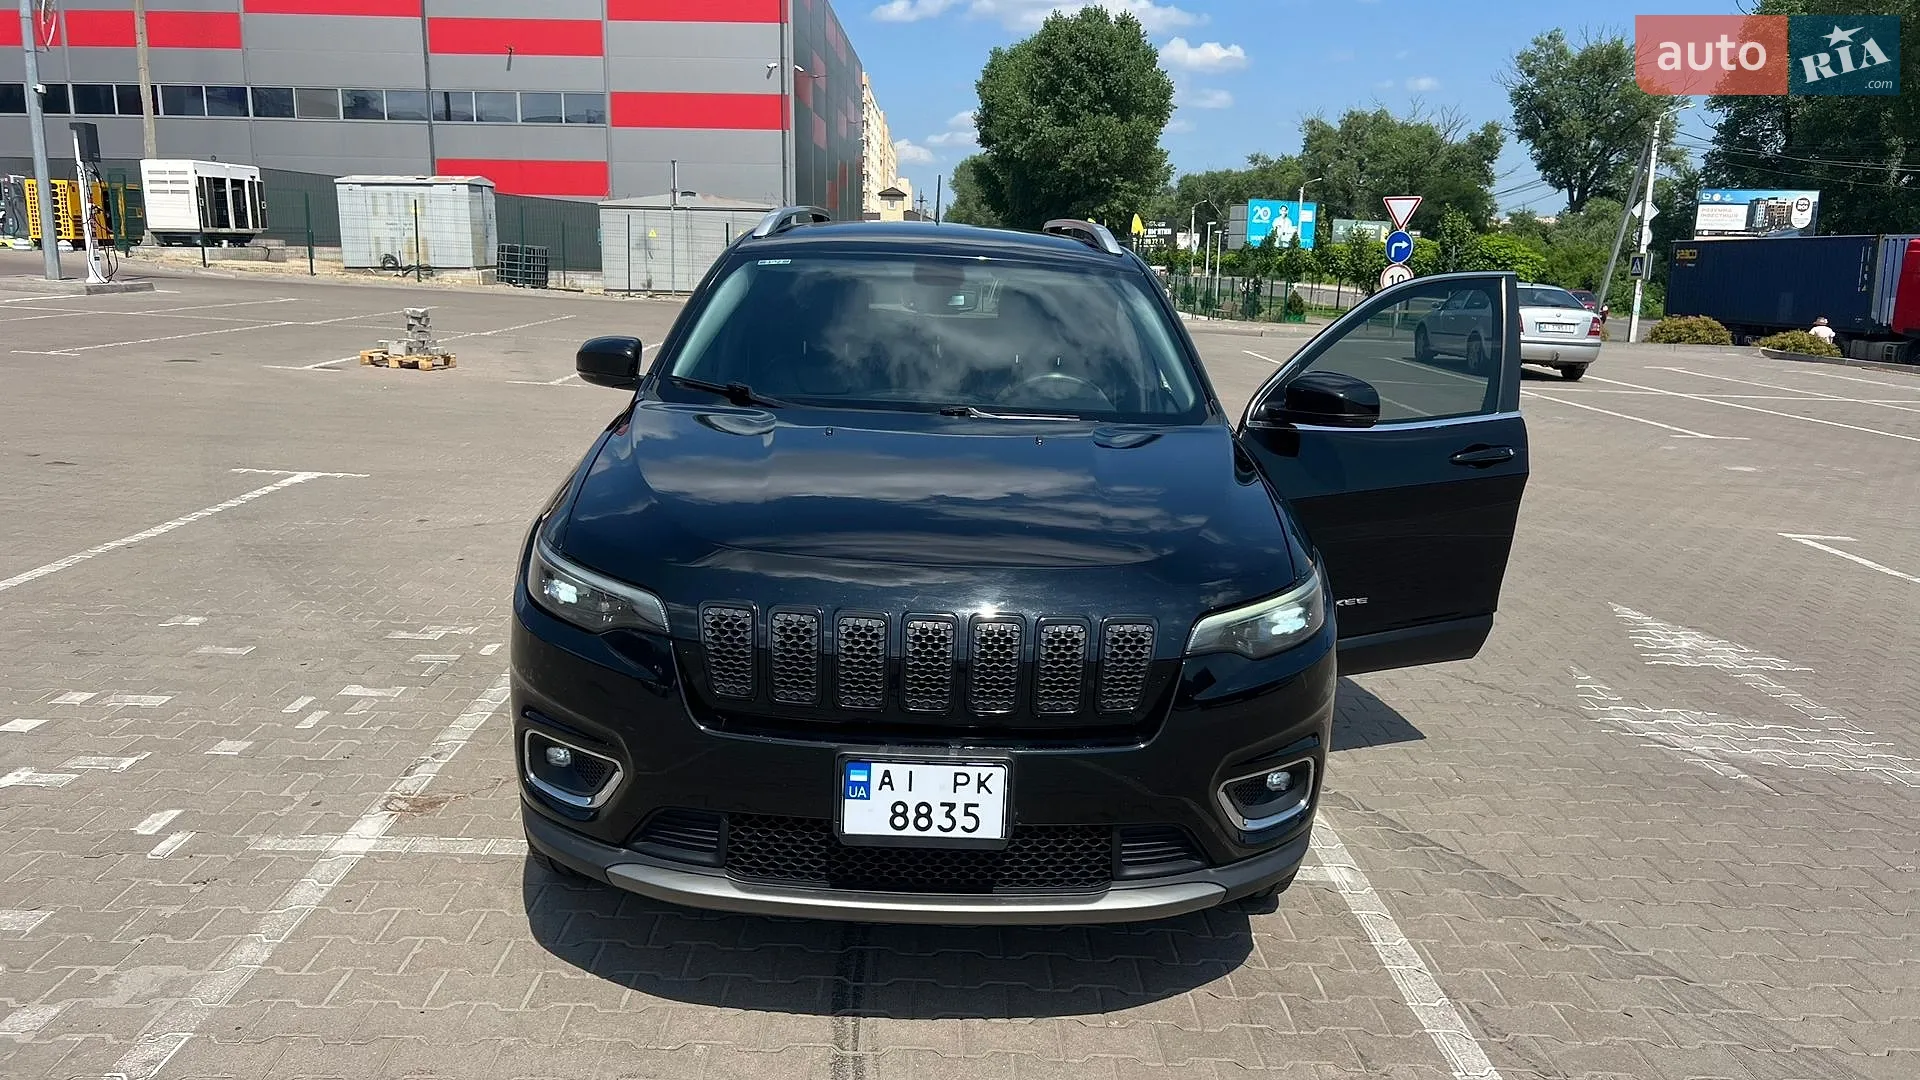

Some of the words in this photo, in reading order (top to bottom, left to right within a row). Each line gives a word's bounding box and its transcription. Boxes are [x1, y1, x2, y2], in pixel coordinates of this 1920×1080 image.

[1389, 274, 1405, 285] 10
[878, 769, 913, 792] AI
[953, 772, 994, 794] PK
[848, 786, 867, 798] UA
[889, 800, 980, 833] 8835
